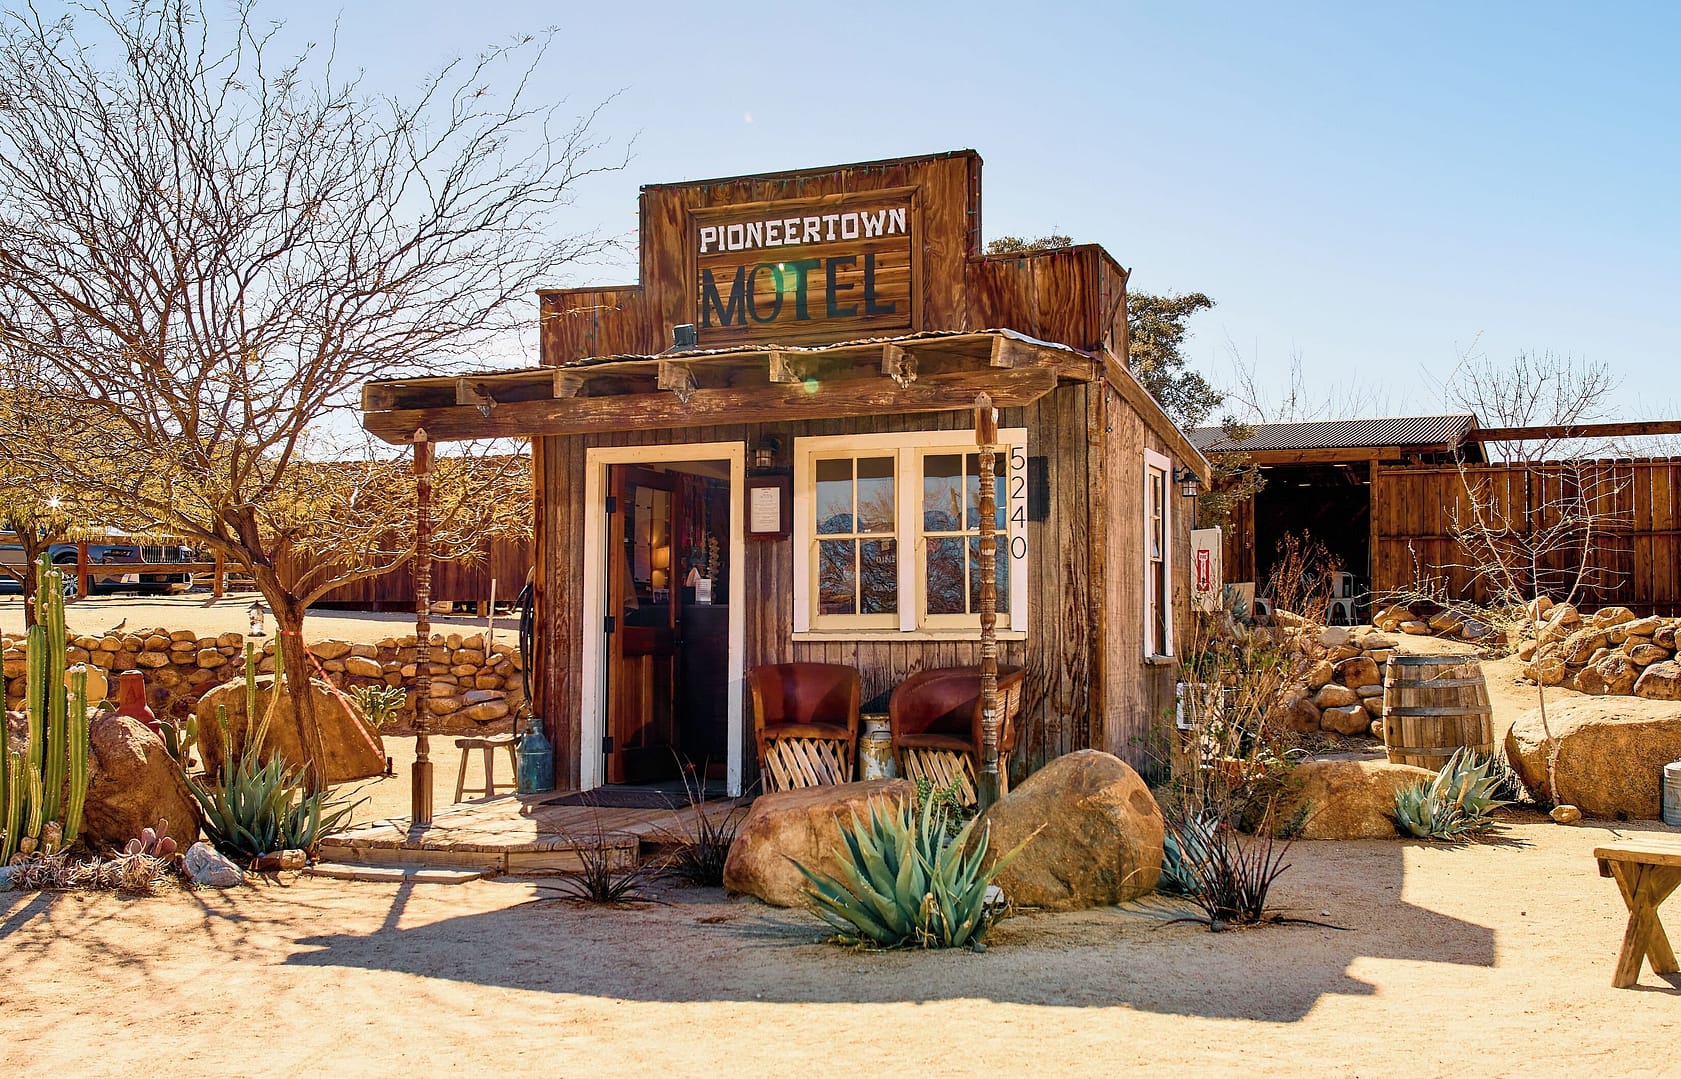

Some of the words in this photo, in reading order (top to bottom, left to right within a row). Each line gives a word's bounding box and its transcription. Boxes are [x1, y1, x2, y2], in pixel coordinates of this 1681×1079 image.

[700, 208, 906, 252] PIONEERTOWN
[702, 254, 896, 327] MOTEL
[1011, 447, 1027, 559] 5240
